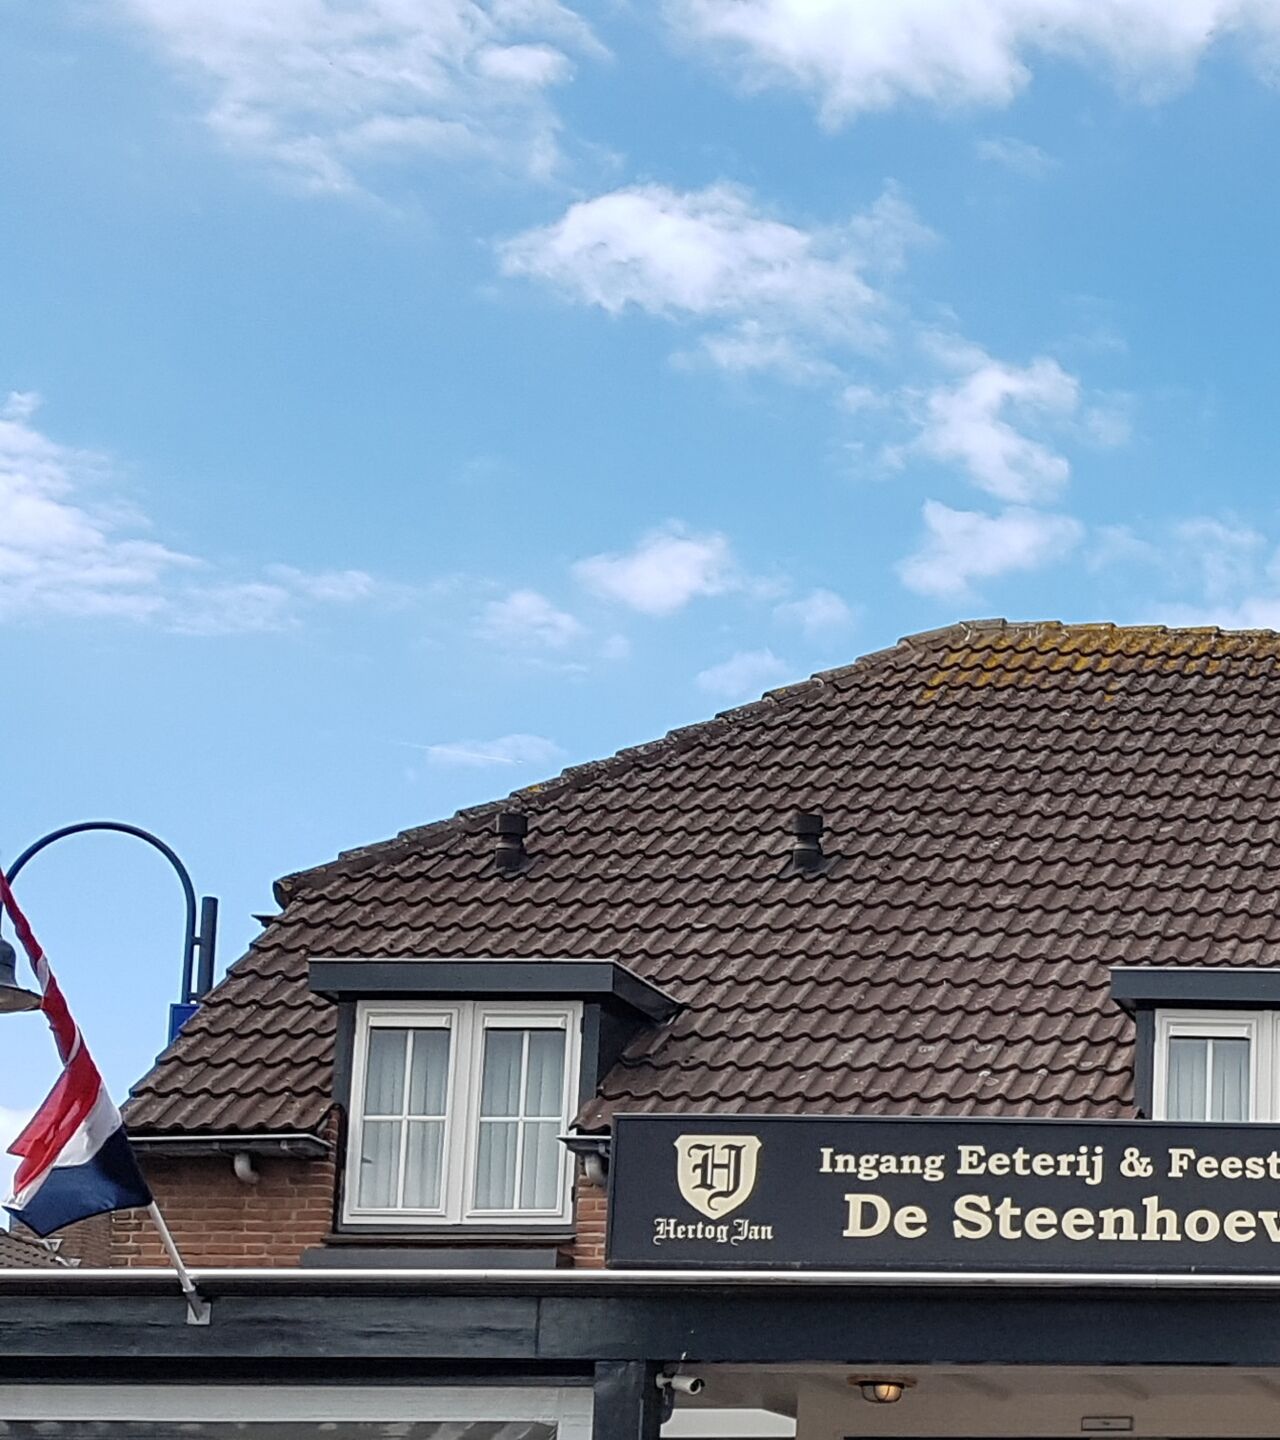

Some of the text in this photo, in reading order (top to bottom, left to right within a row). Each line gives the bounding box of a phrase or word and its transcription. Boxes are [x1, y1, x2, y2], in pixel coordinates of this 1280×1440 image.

[820, 1147, 945, 1182] Ingang
[957, 1145, 1103, 1186] Eeterij
[1120, 1148, 1153, 1178] &
[653, 1218, 774, 1246] Hertog Jan
[842, 1193, 928, 1239] De
